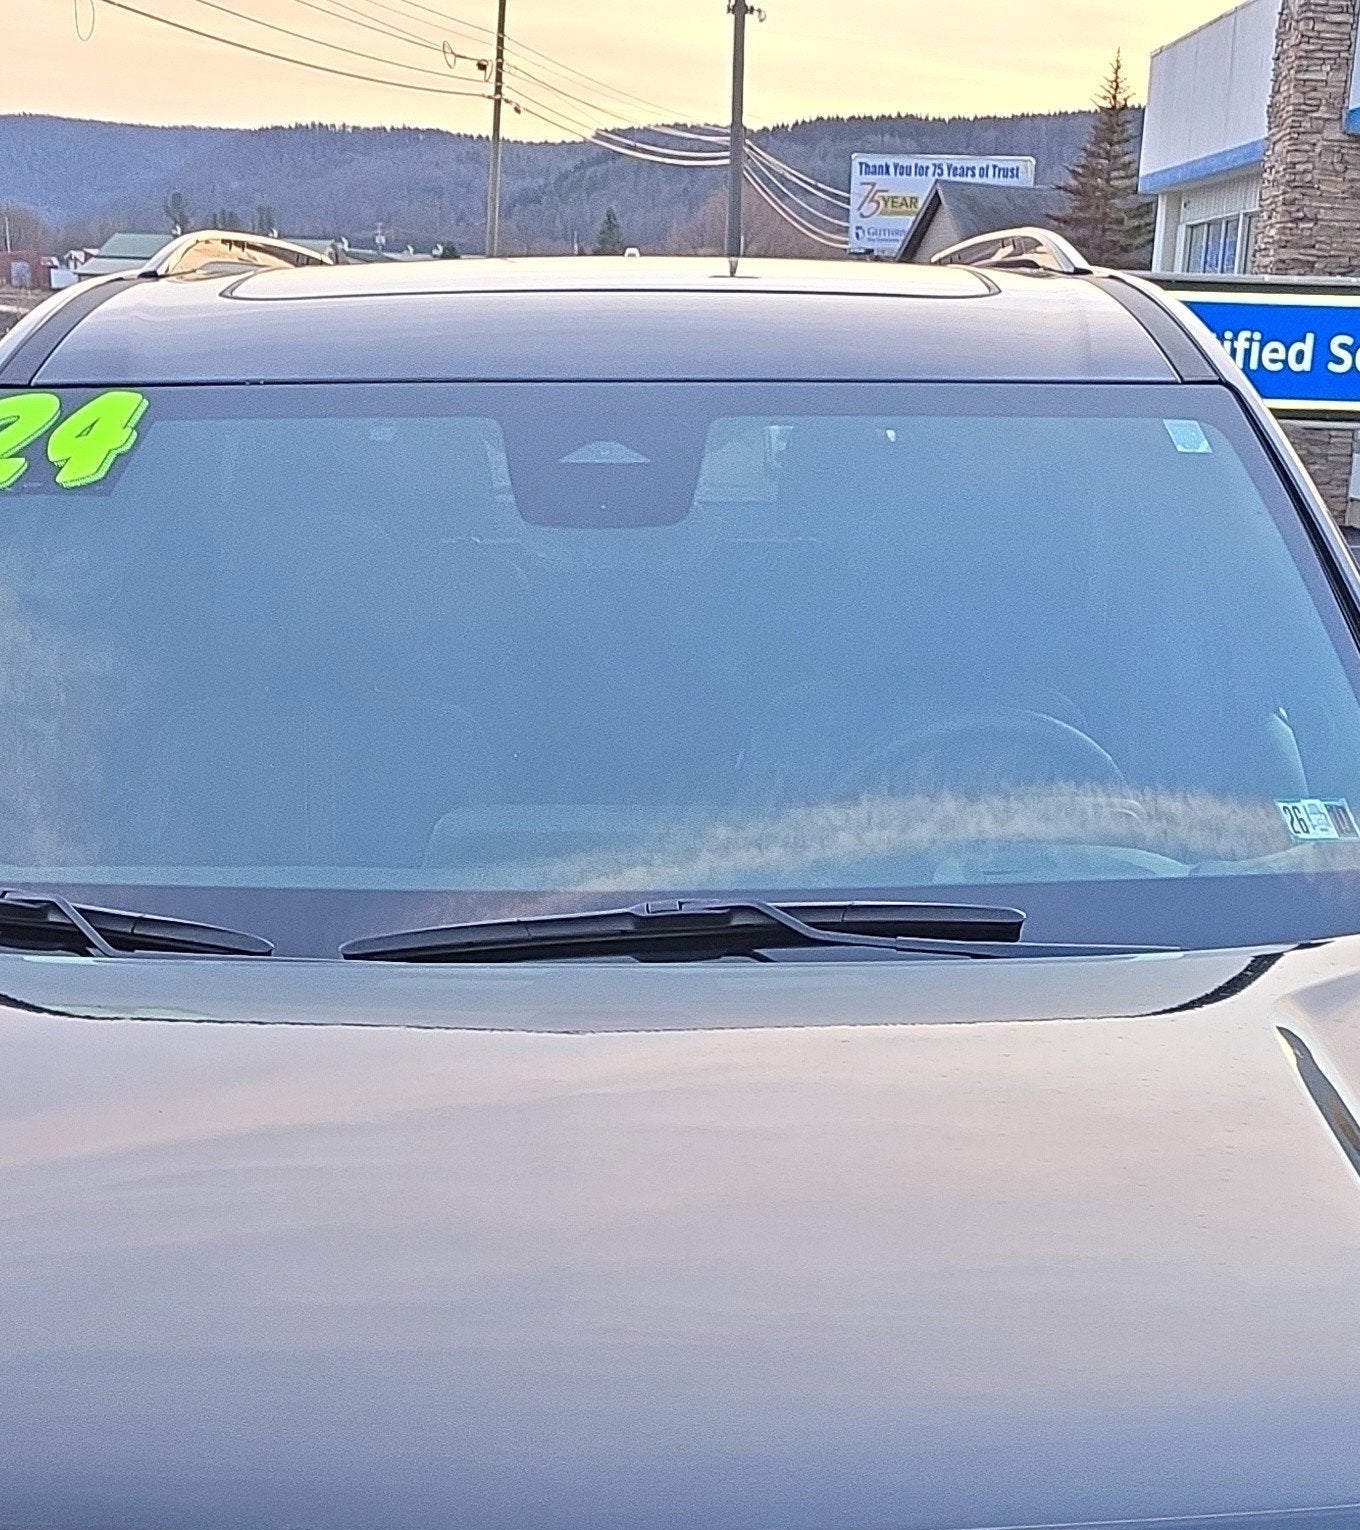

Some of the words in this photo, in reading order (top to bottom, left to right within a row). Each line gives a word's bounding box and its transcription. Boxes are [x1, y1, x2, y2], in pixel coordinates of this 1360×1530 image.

[858, 162, 891, 176] Thank
[893, 162, 912, 177] You
[914, 163, 930, 177] for
[932, 163, 944, 178] 75
[946, 163, 976, 178] Years
[978, 164, 989, 178] of
[992, 165, 1020, 180] Trust
[857, 182, 889, 218] 75
[1213, 330, 1315, 372] ified
[1283, 805, 1311, 834] 26
